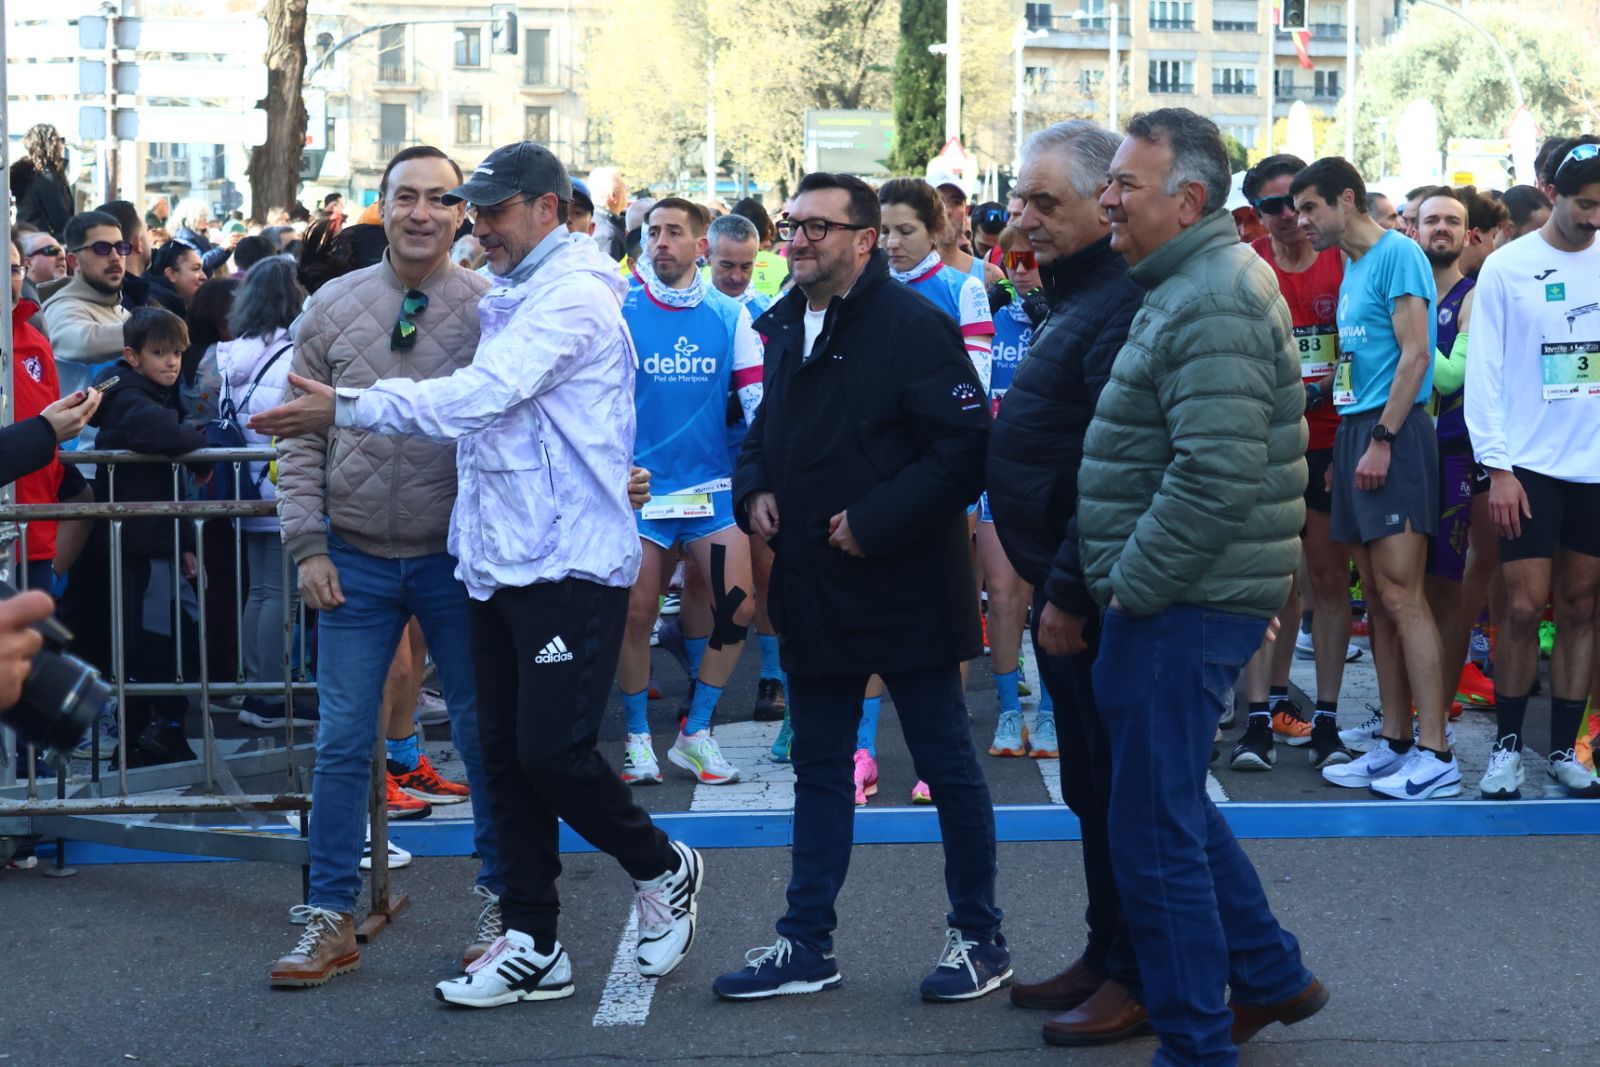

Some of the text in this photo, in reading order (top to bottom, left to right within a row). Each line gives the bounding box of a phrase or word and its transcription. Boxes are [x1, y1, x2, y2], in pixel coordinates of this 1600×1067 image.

[992, 341, 1029, 361] deb
[643, 353, 716, 374] debra
[1577, 356, 1589, 371] 3
[654, 375, 667, 383] Piel
[678, 375, 708, 384] Mariposa
[534, 651, 573, 664] adidas
